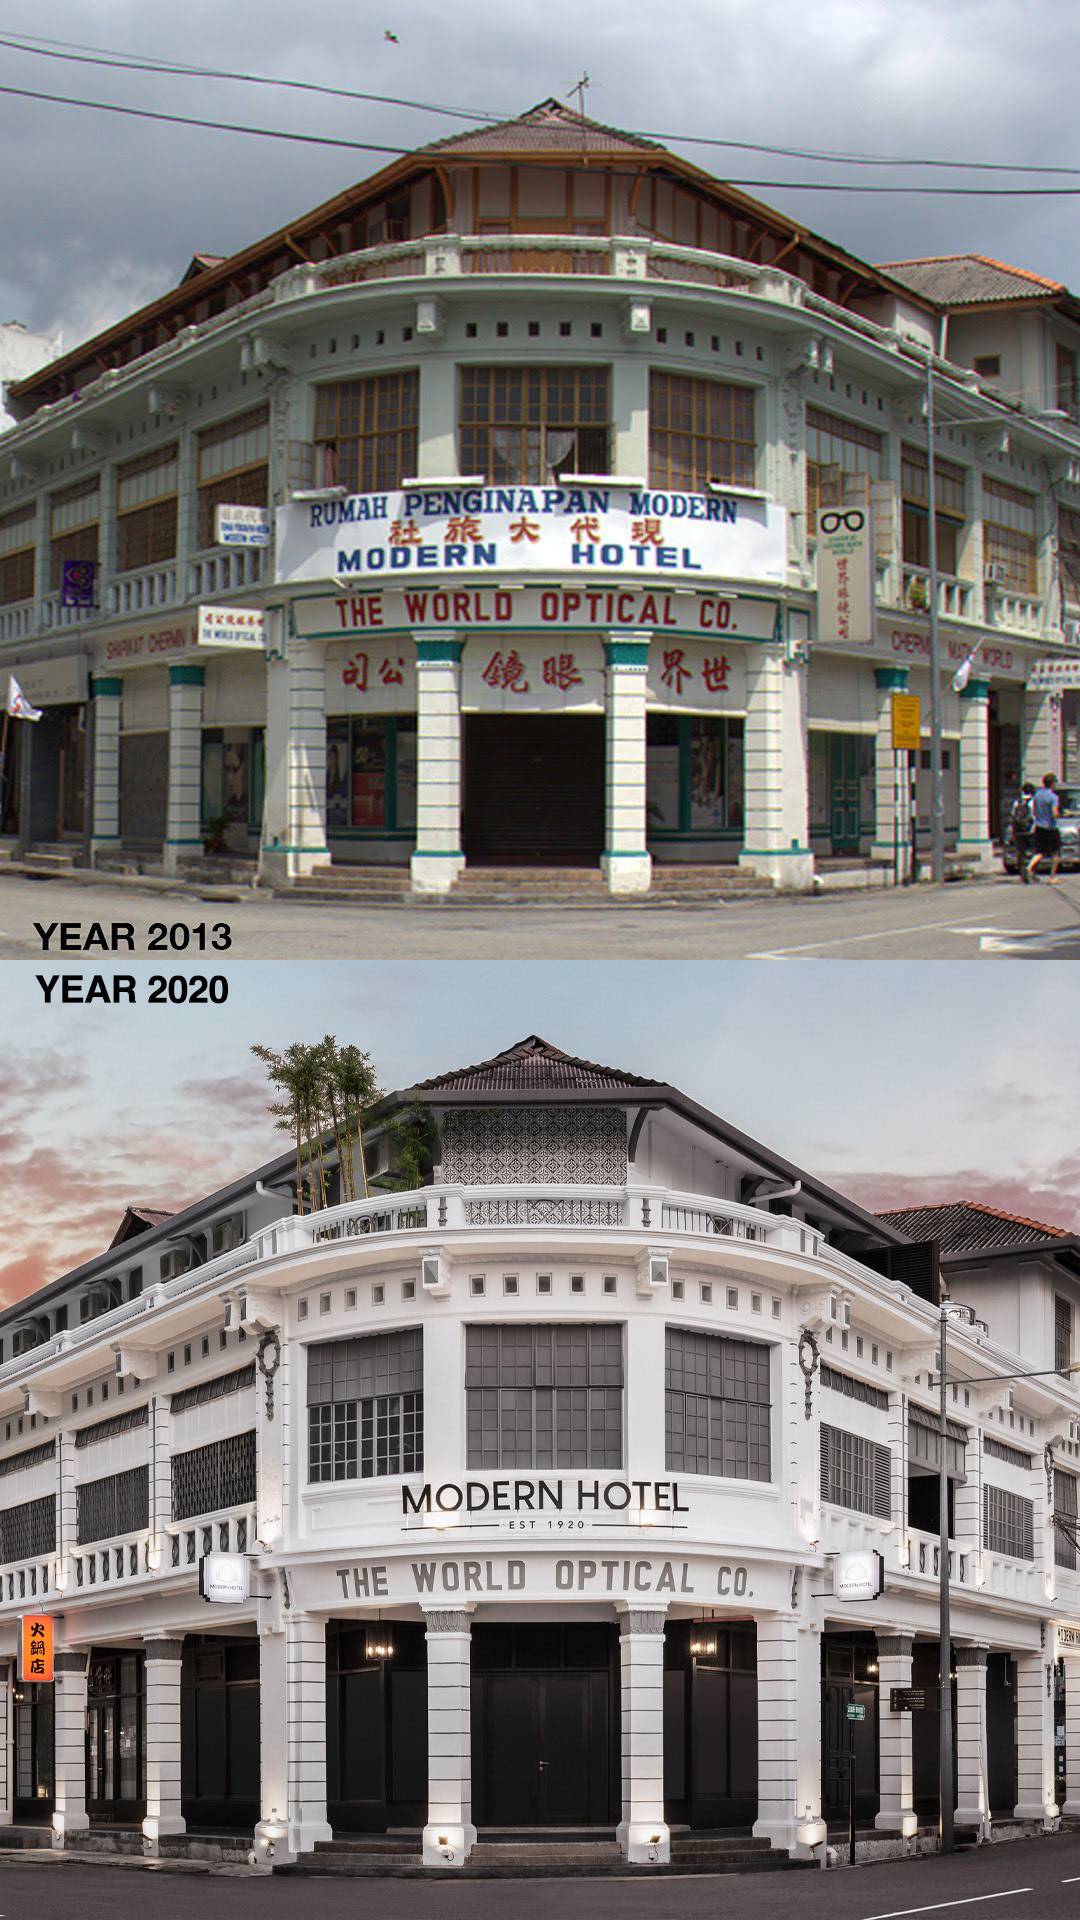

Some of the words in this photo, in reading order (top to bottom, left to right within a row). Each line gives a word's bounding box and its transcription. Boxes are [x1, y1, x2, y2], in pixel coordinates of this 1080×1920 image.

[310, 496, 388, 527] RUMAH
[404, 490, 609, 516] PENGINAPAN
[629, 492, 737, 523] MODERN
[337, 543, 497, 573] MODERN
[571, 543, 702, 570] HOTEL
[335, 597, 384, 628] THE
[404, 592, 512, 623] WORLD
[541, 592, 677, 625] OPTICAL
[700, 599, 737, 630] CO.
[401, 1480, 562, 1514] MODERN
[578, 1480, 689, 1512] HOTEL
[509, 1521, 536, 1530] EST
[548, 1520, 584, 1530] 1920
[336, 1566, 389, 1599] THE
[411, 1561, 526, 1593] WORLD
[555, 1560, 694, 1593] OPTICAL
[717, 1566, 754, 1598] CO.
[30, 1622, 45, 1675] 火鍋店
